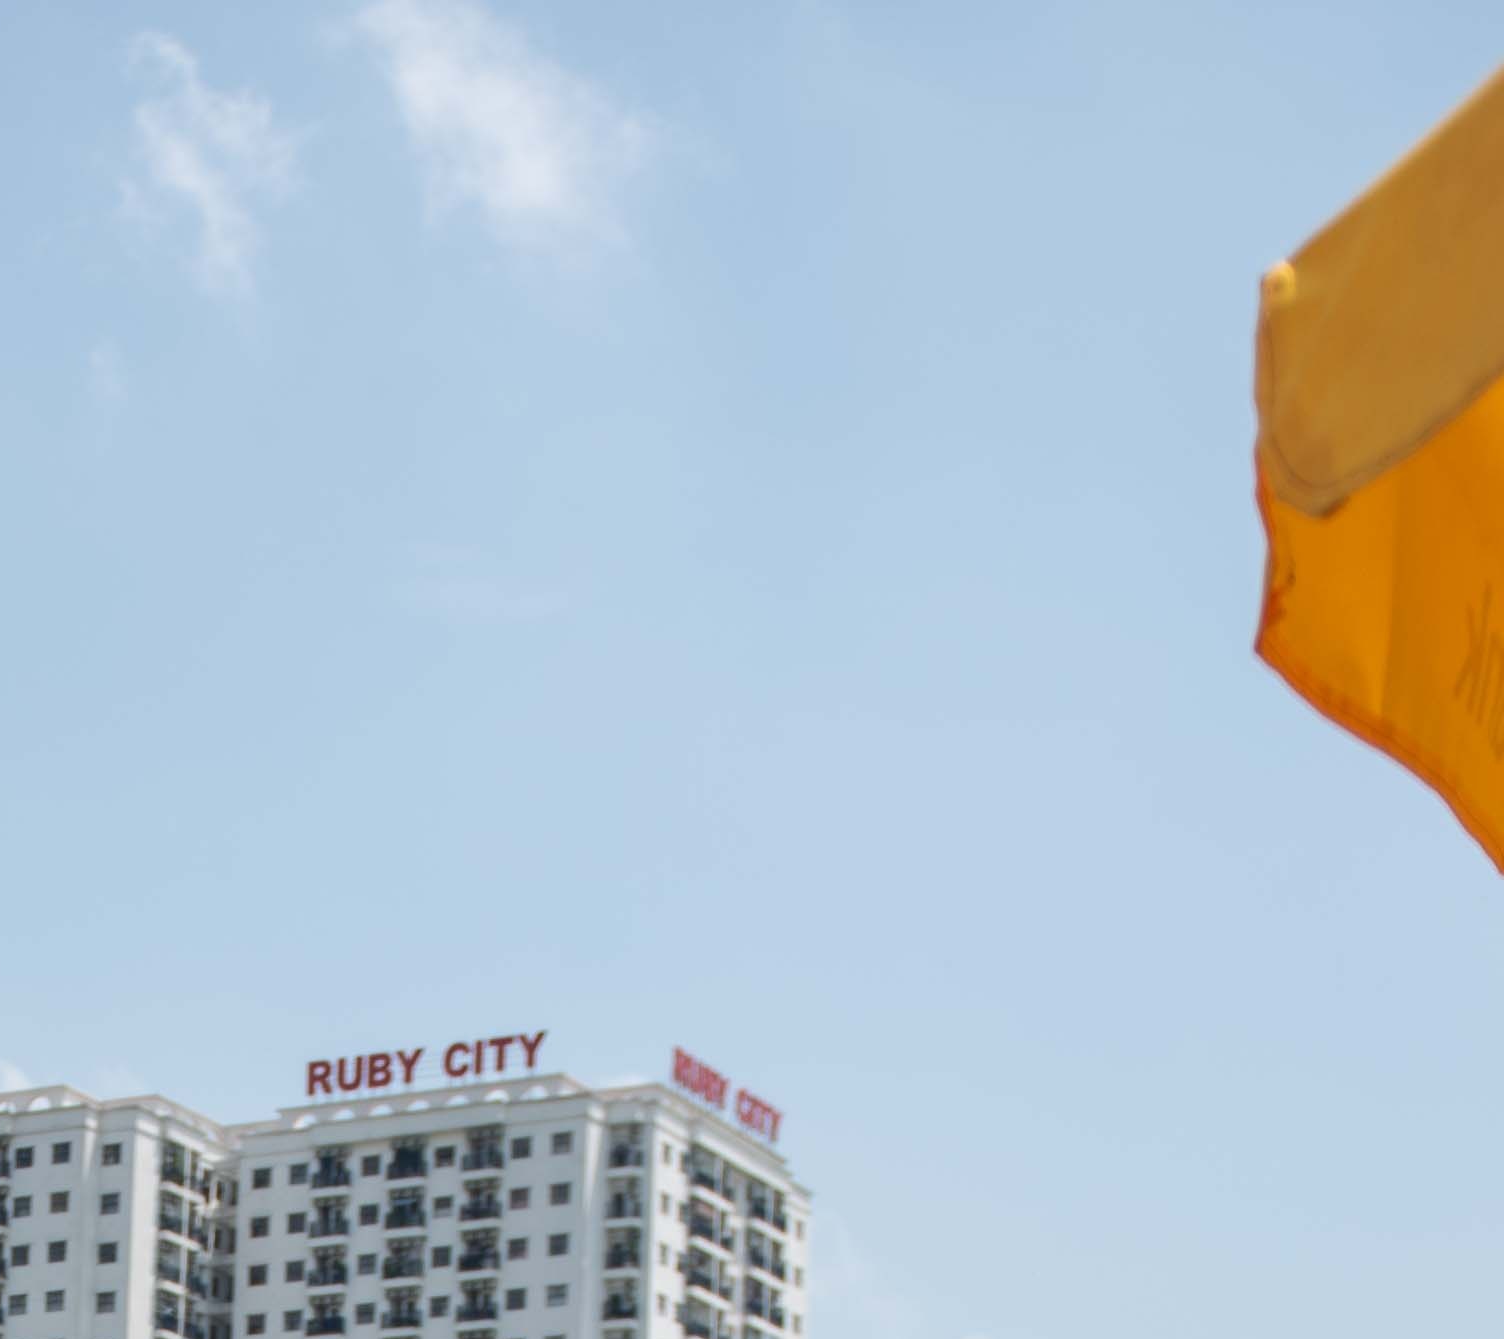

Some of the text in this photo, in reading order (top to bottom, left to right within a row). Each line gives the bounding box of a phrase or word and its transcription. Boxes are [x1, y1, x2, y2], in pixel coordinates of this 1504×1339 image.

[306, 1029, 548, 1096] RUBY CITY
[736, 1087, 782, 1143] CITY
